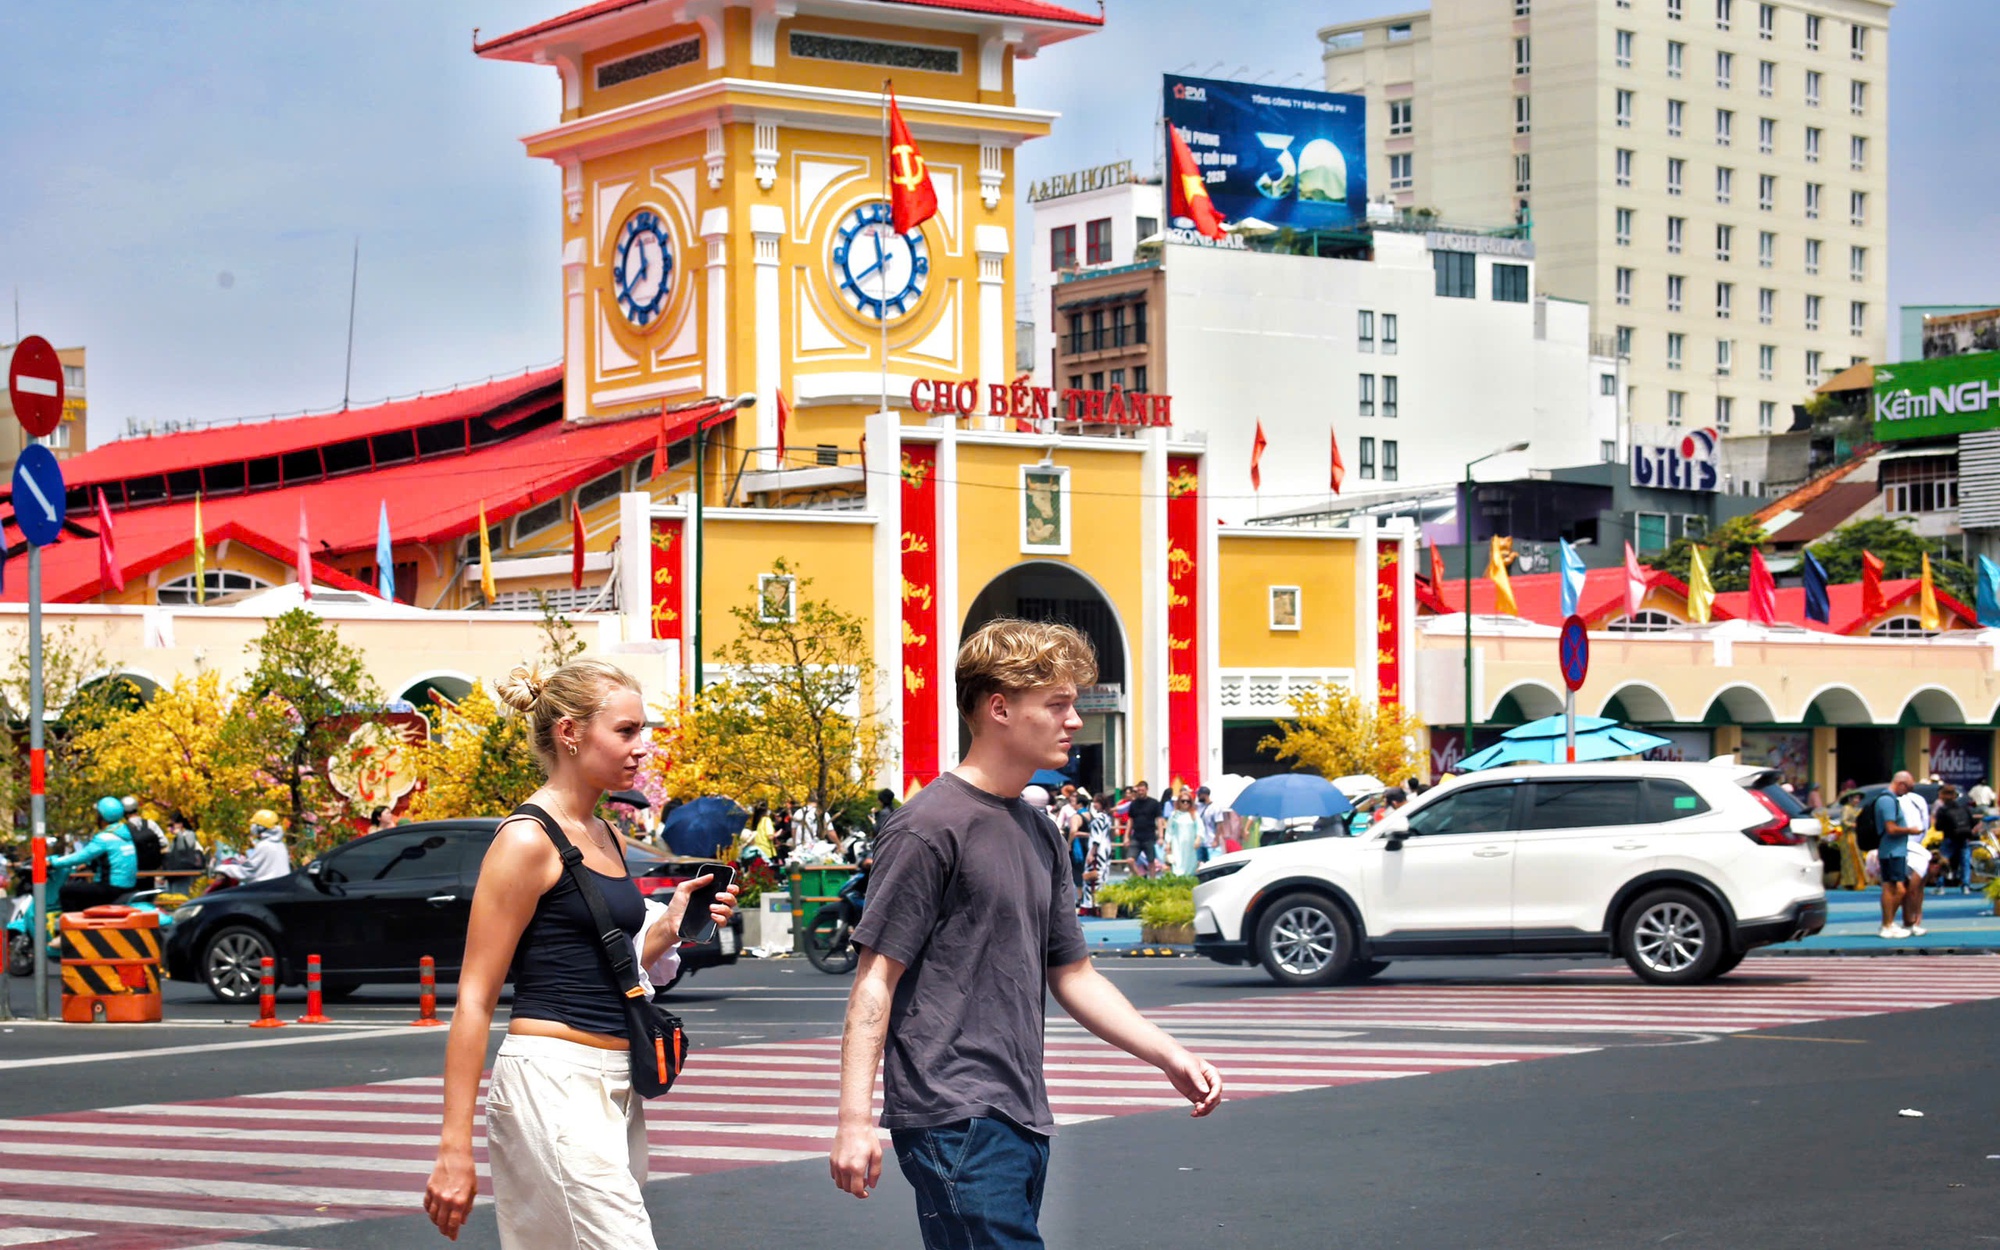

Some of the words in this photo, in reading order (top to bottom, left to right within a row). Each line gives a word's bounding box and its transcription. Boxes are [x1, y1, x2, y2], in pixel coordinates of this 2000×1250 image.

[1027, 173, 1077, 203] A&EM
[1081, 160, 1132, 193] HOTEL
[910, 378, 979, 419] CHỢ
[988, 374, 1053, 419] BẾN
[1061, 383, 1173, 427] THÀNH
